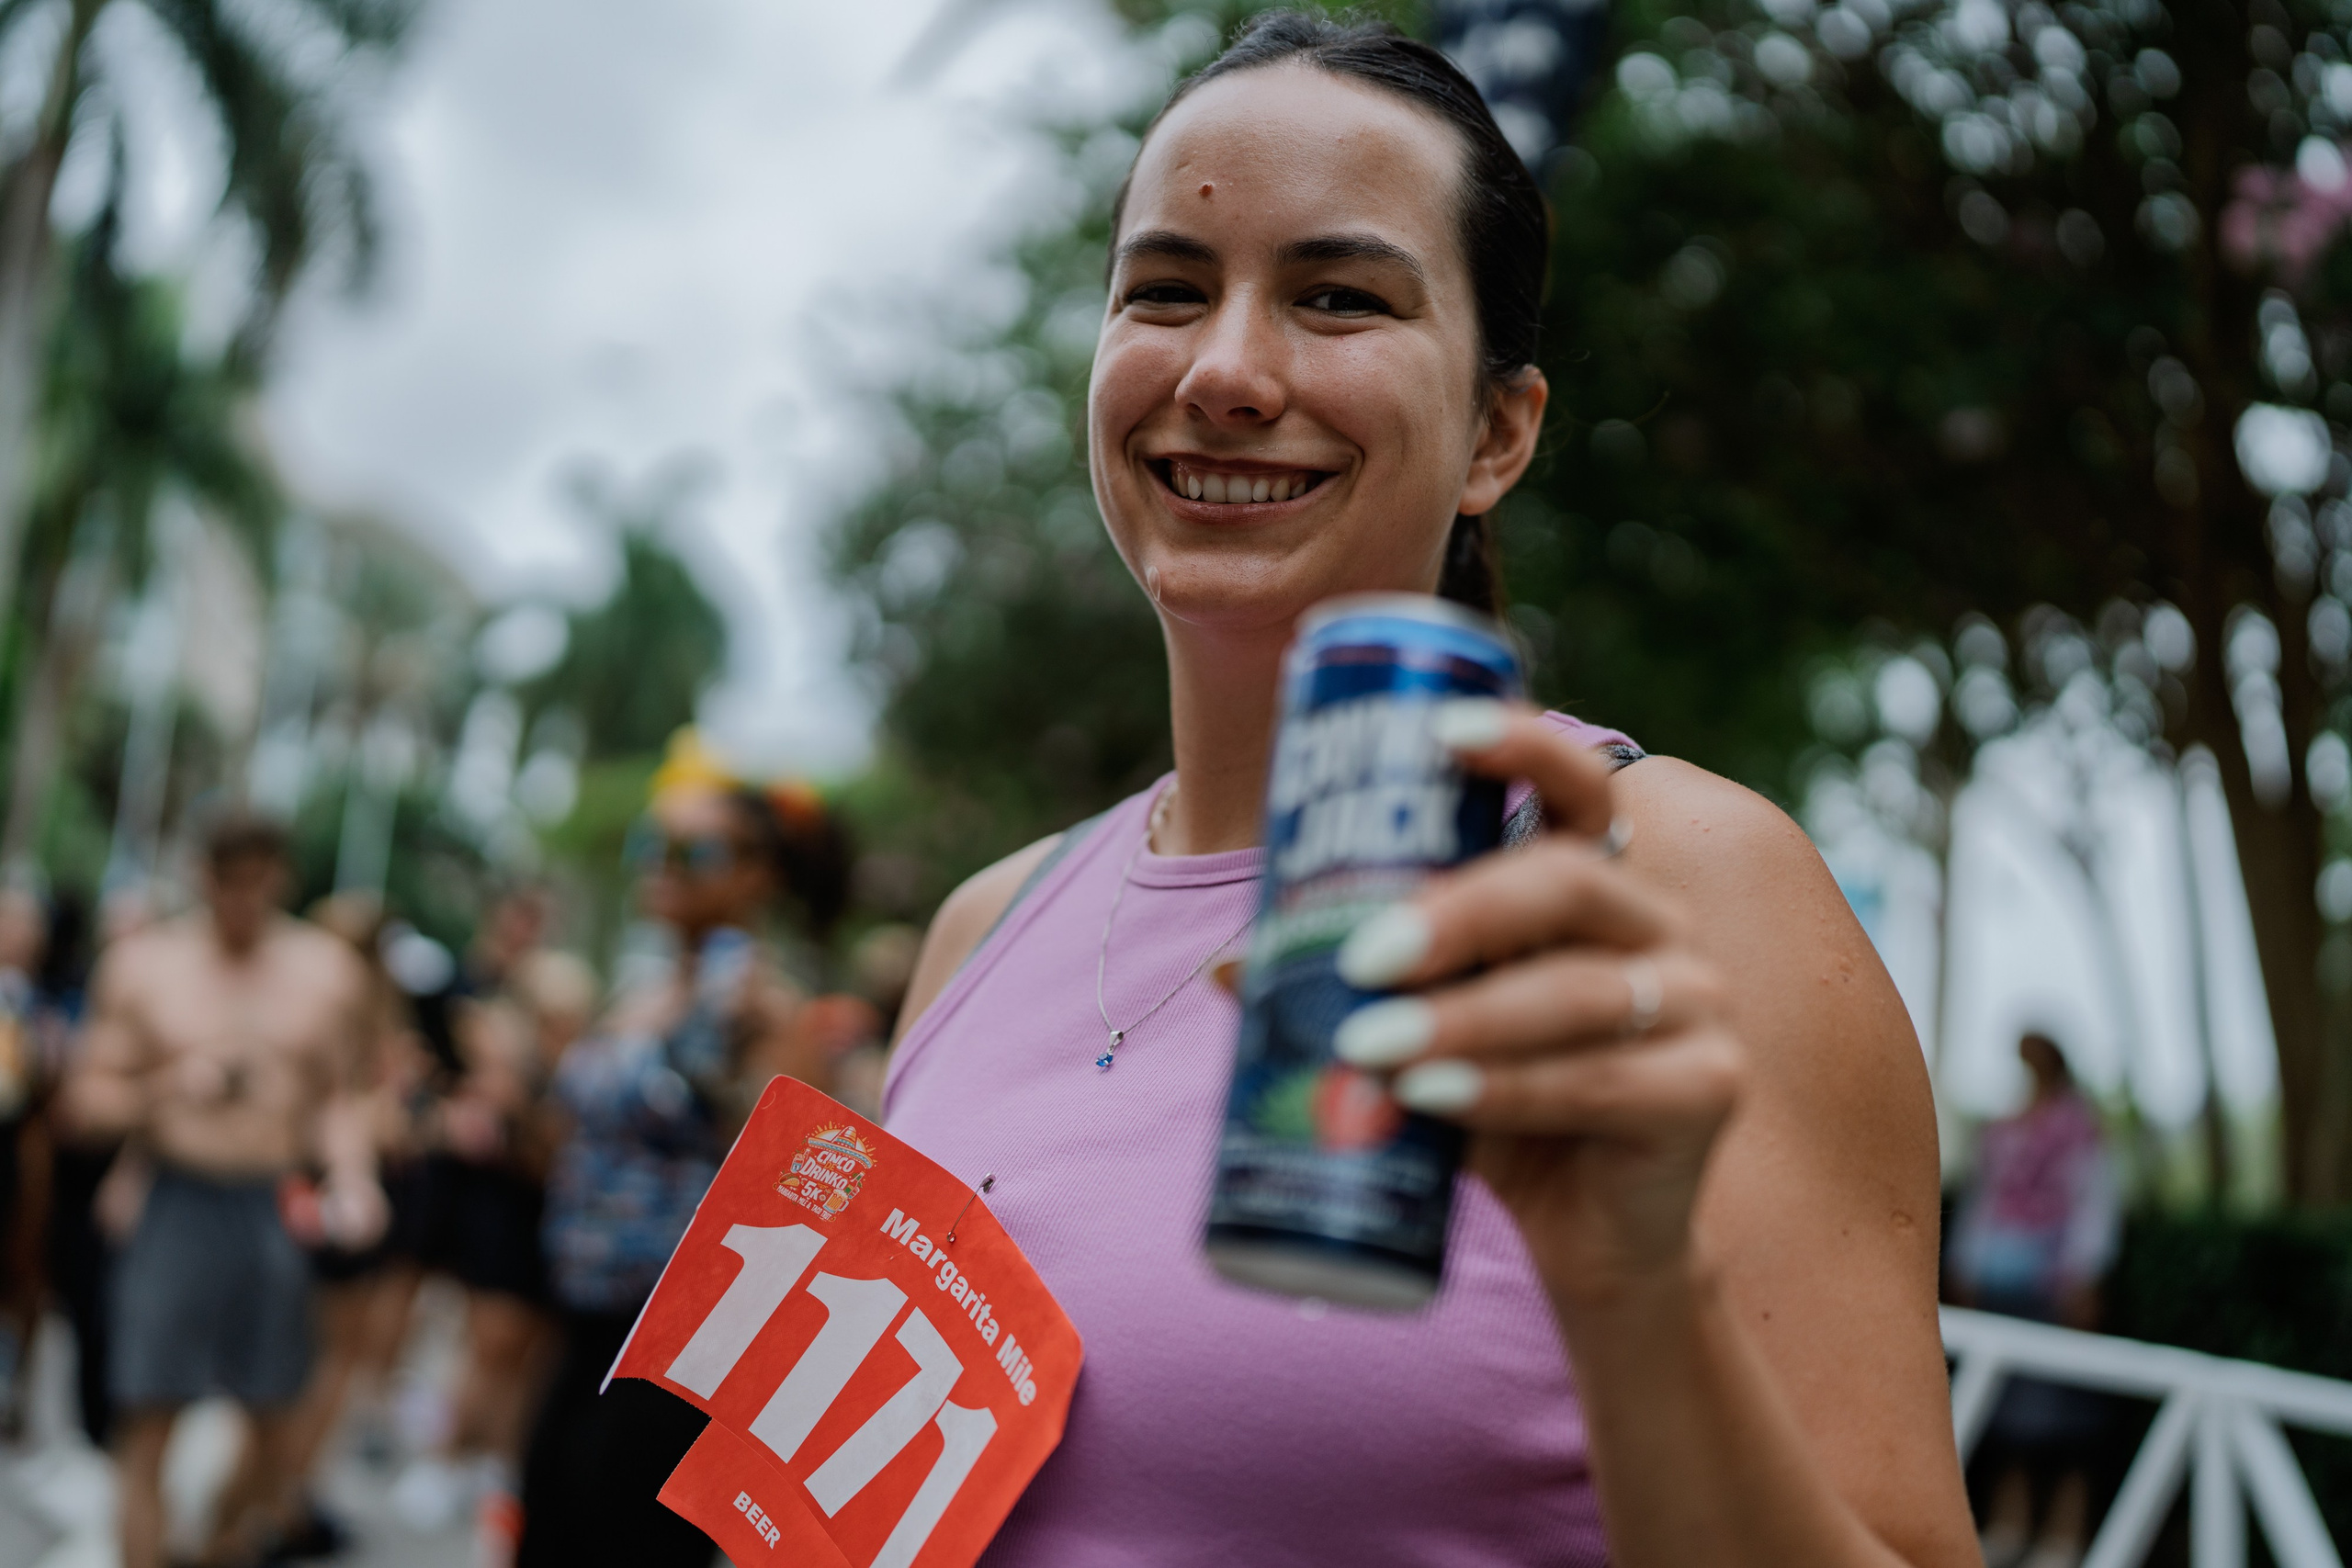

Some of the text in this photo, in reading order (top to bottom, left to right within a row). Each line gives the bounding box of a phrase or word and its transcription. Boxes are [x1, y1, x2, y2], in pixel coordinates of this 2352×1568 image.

[799, 1156, 848, 1190] DRINKO
[817, 1150, 856, 1173] CINCO
[824, 1162, 836, 1171] DE
[801, 1180, 822, 1201] 5K
[811, 1204, 823, 1215] TACO
[879, 1207, 1038, 1407] Margarita Mile
[663, 1222, 1000, 1568] 1171
[732, 1490, 782, 1550] BEER
